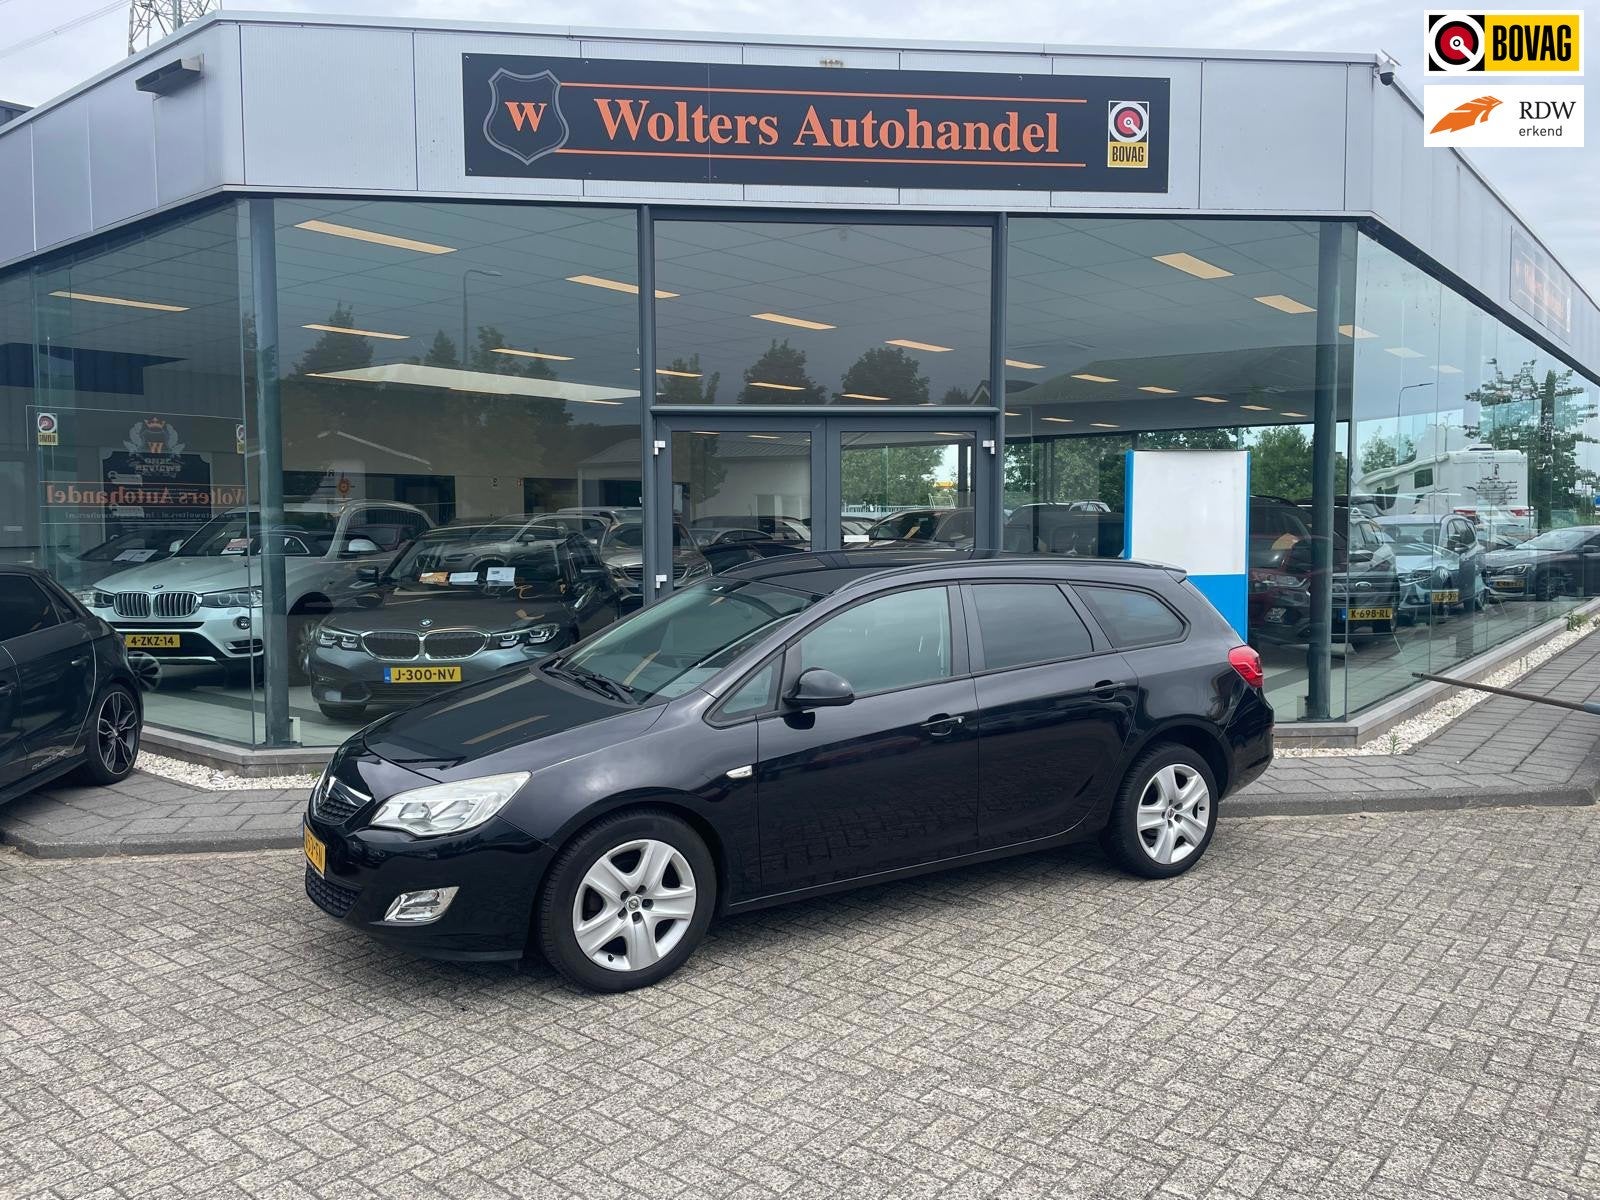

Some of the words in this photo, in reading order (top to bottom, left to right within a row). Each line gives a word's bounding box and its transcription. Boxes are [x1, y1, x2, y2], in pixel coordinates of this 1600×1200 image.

[505, 101, 548, 132] W
[594, 98, 779, 146] Wolters
[793, 104, 1059, 153] Autohandel
[1111, 146, 1145, 163] BOVAG
[1351, 609, 1390, 619] K-698-RL
[130, 636, 175, 646] 4-ZKZ-14
[395, 668, 455, 681] J-300-NV
